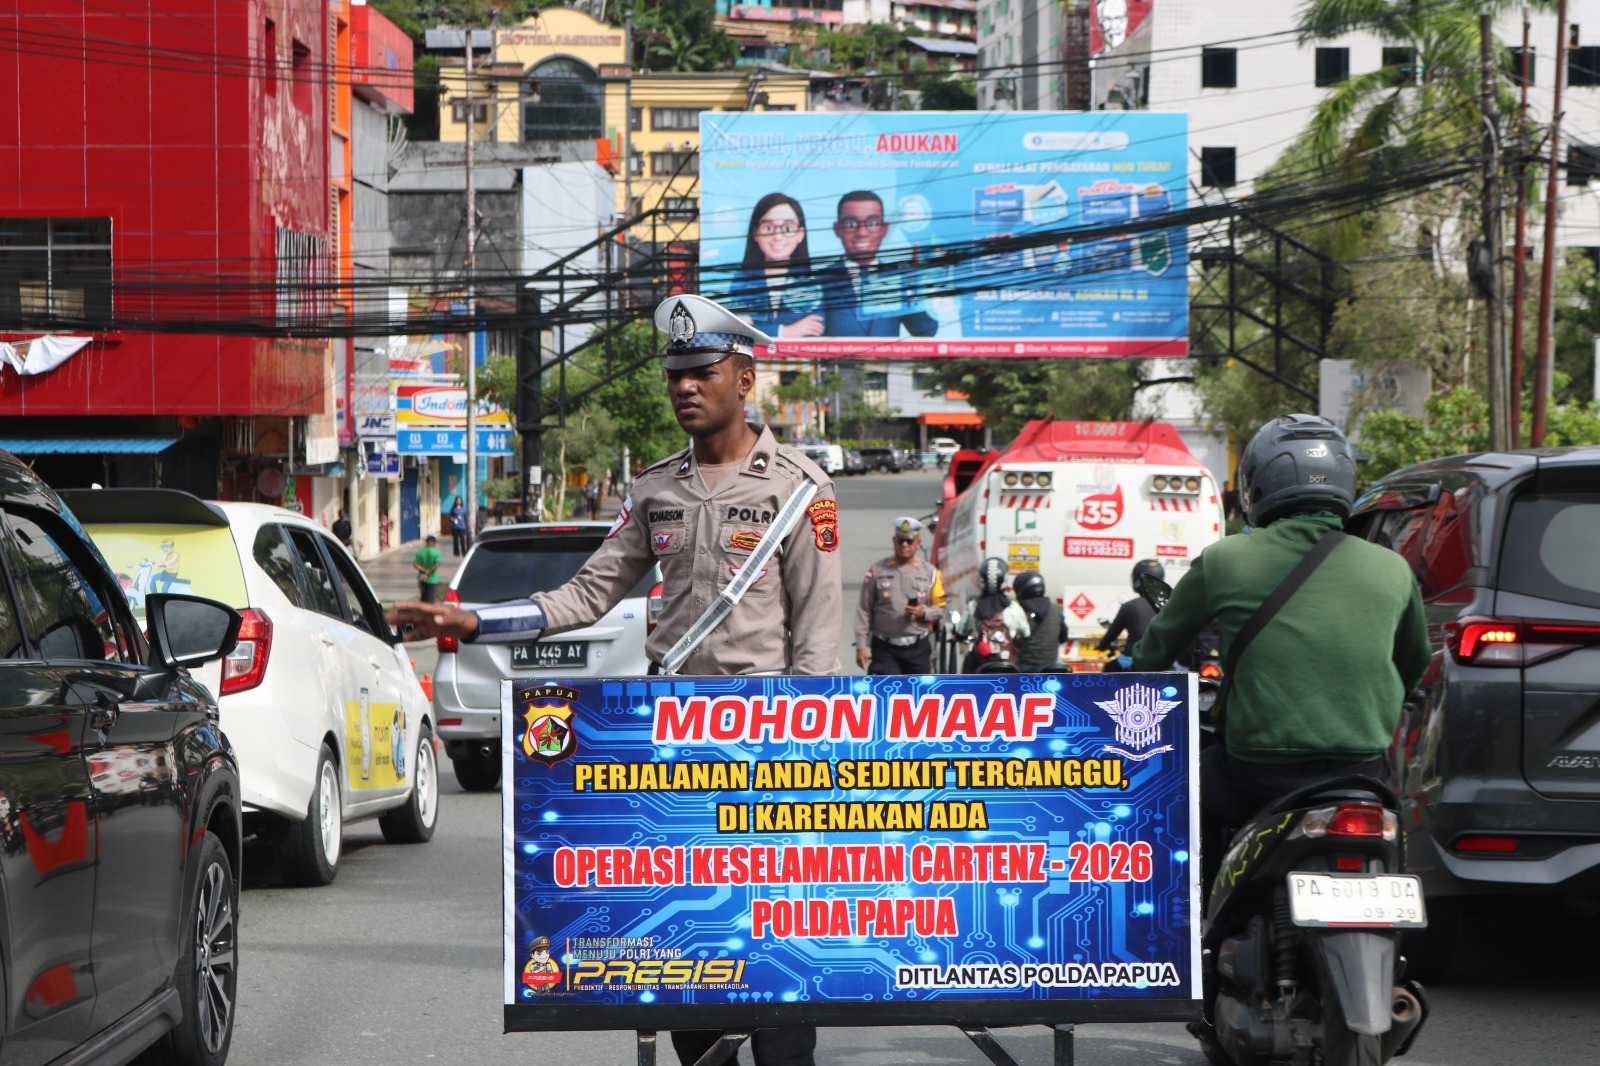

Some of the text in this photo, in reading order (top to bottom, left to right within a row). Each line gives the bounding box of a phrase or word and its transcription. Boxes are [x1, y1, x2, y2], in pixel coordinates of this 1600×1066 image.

[875, 133, 958, 153] ADUKAN
[809, 501, 835, 513] POLDA
[1077, 501, 1118, 525] 135
[814, 513, 834, 522] PAPUA
[514, 644, 582, 660] PA 1445 AY
[525, 689, 573, 699] PAPUA
[653, 695, 1055, 743] MOHON MAAF
[574, 759, 1129, 791] PERJALANAN ANDA SEDIKIT TERGANGGU,
[718, 801, 988, 832] DI KARENAKAN ADA
[554, 846, 686, 886] OPERASI
[691, 844, 905, 885] KESELAMATAN
[911, 843, 1047, 883] CARTENZ
[1069, 842, 1153, 883] 2026
[1297, 879, 1322, 897] PA
[751, 898, 958, 939] POLDA PAPUA
[572, 936, 654, 949] TRANSFORMASI
[573, 948, 682, 960] MENUJU POLRI YANG
[573, 959, 748, 985] PRESISI
[898, 965, 1178, 986] DITLANTAS POLDA PAPUA
[665, 983, 708, 991] TRANSPARANSI
